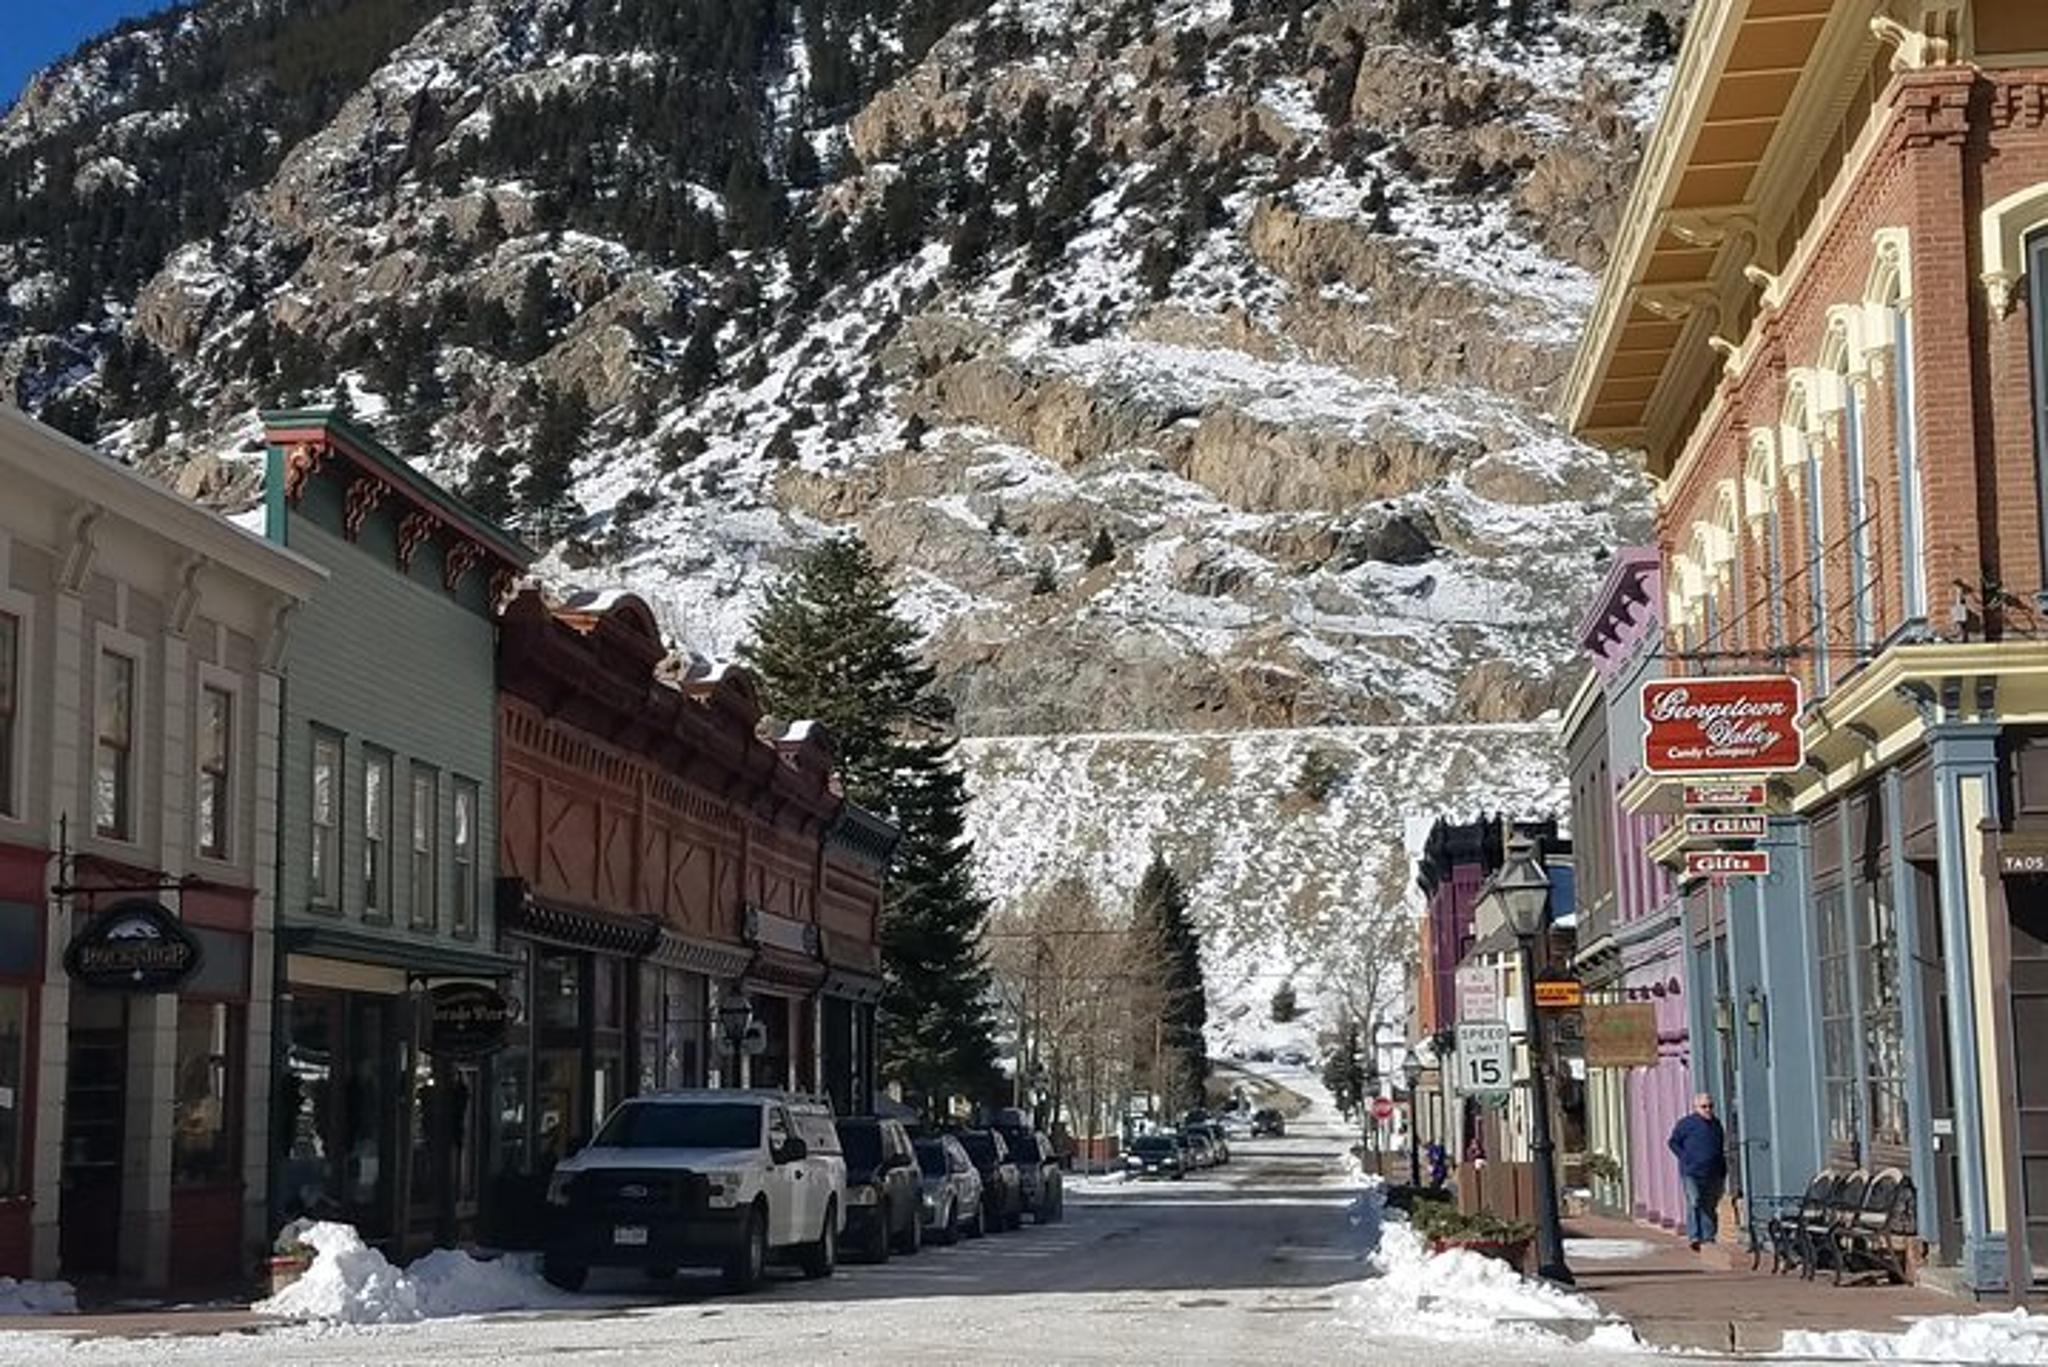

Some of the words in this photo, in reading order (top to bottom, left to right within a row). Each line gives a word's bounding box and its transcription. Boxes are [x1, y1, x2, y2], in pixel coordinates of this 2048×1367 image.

[1651, 687, 1787, 729] Georgetown
[1706, 719, 1783, 751] Valley
[1667, 747, 1702, 759] Candy
[1706, 746, 1760, 759] Company
[1689, 819, 1709, 833] ICE
[1713, 818, 1761, 833] CREAM
[1696, 856, 1751, 869] Gifts
[2004, 856, 2044, 870] TAOS
[1461, 1027, 1504, 1040] SPEED
[1466, 1042, 1500, 1055] LIMIT
[1469, 1058, 1502, 1085] 15
